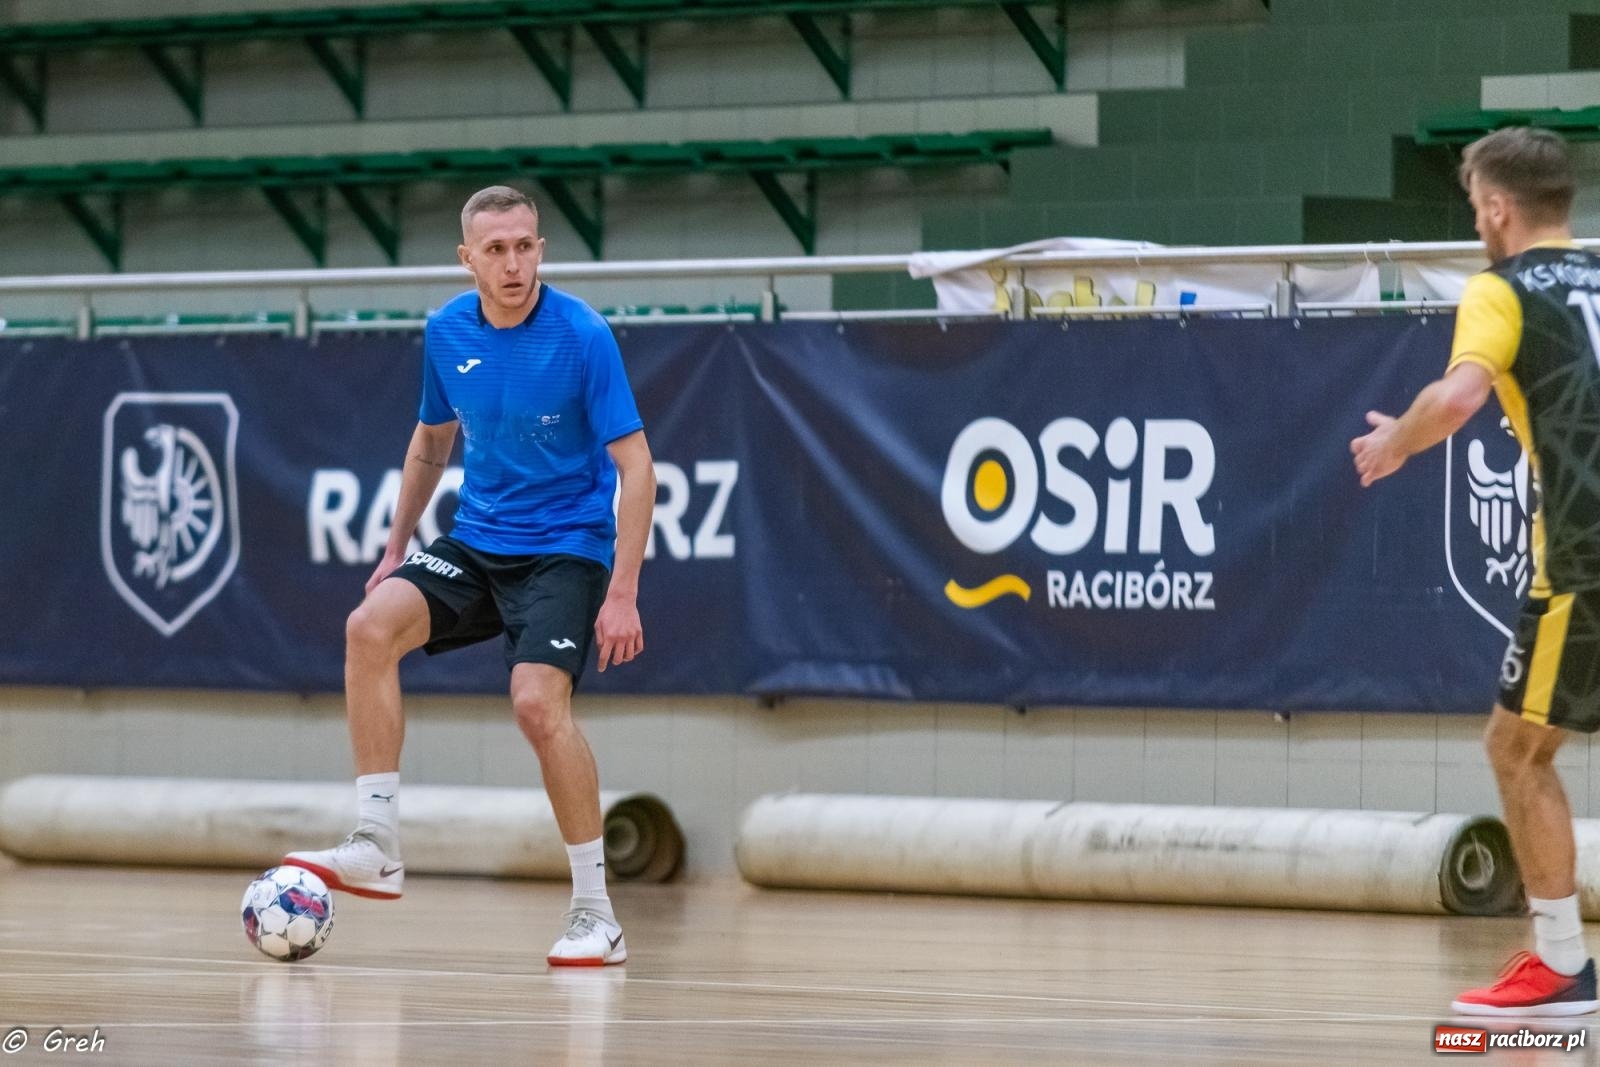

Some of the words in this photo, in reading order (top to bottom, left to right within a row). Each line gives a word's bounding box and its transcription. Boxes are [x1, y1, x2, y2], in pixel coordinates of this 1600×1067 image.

[308, 460, 739, 564] RACRZ
[406, 551, 463, 578] SPORT
[1047, 559, 1215, 610] RACIBÓRZ
